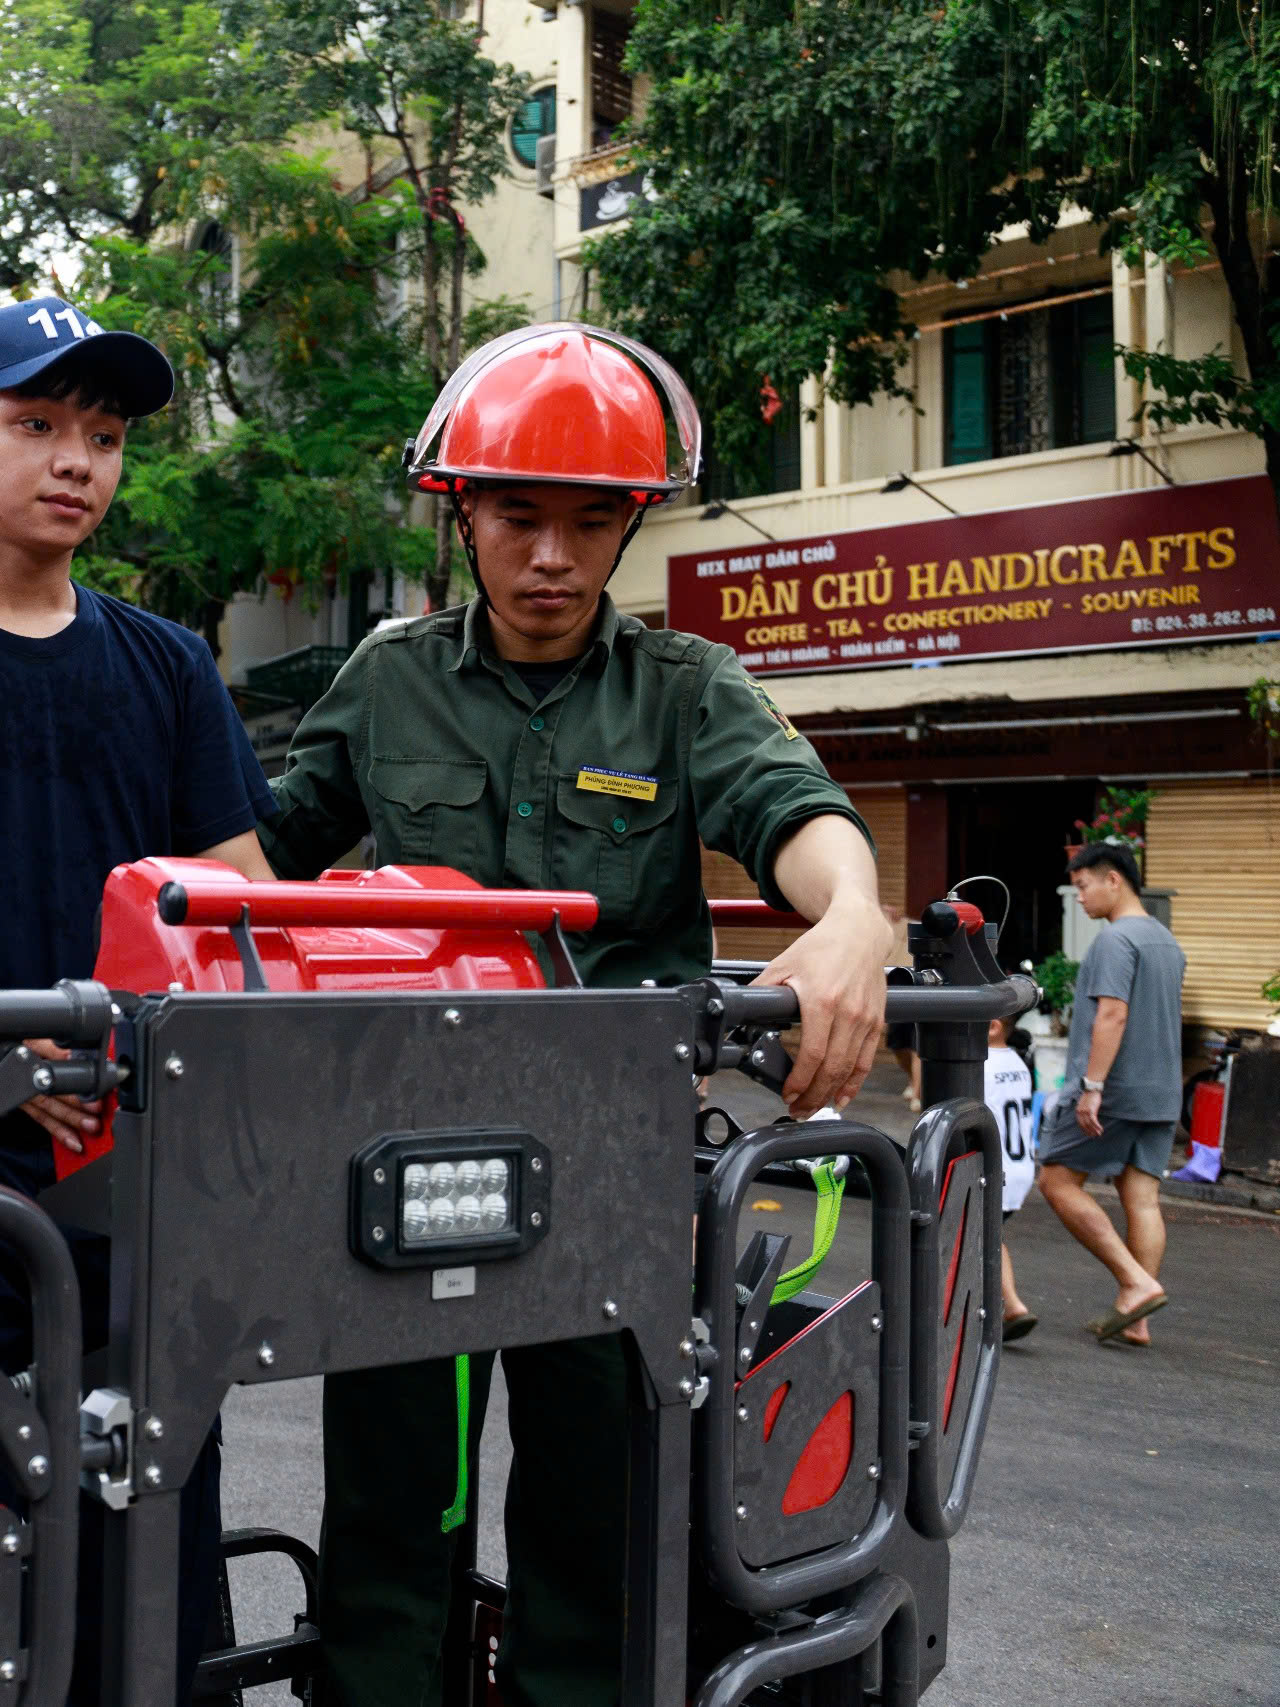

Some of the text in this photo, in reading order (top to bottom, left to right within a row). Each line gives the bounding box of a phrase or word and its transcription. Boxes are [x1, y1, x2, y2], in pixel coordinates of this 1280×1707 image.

[720, 527, 1236, 621] DÂN CHỦ HANDICRAFTS
[728, 554, 762, 573] MAY
[745, 623, 808, 646] COFFEE
[826, 618, 863, 638] TEA
[883, 598, 1053, 632] CONFECTIONERY
[1080, 584, 1201, 614] SOUVENIR
